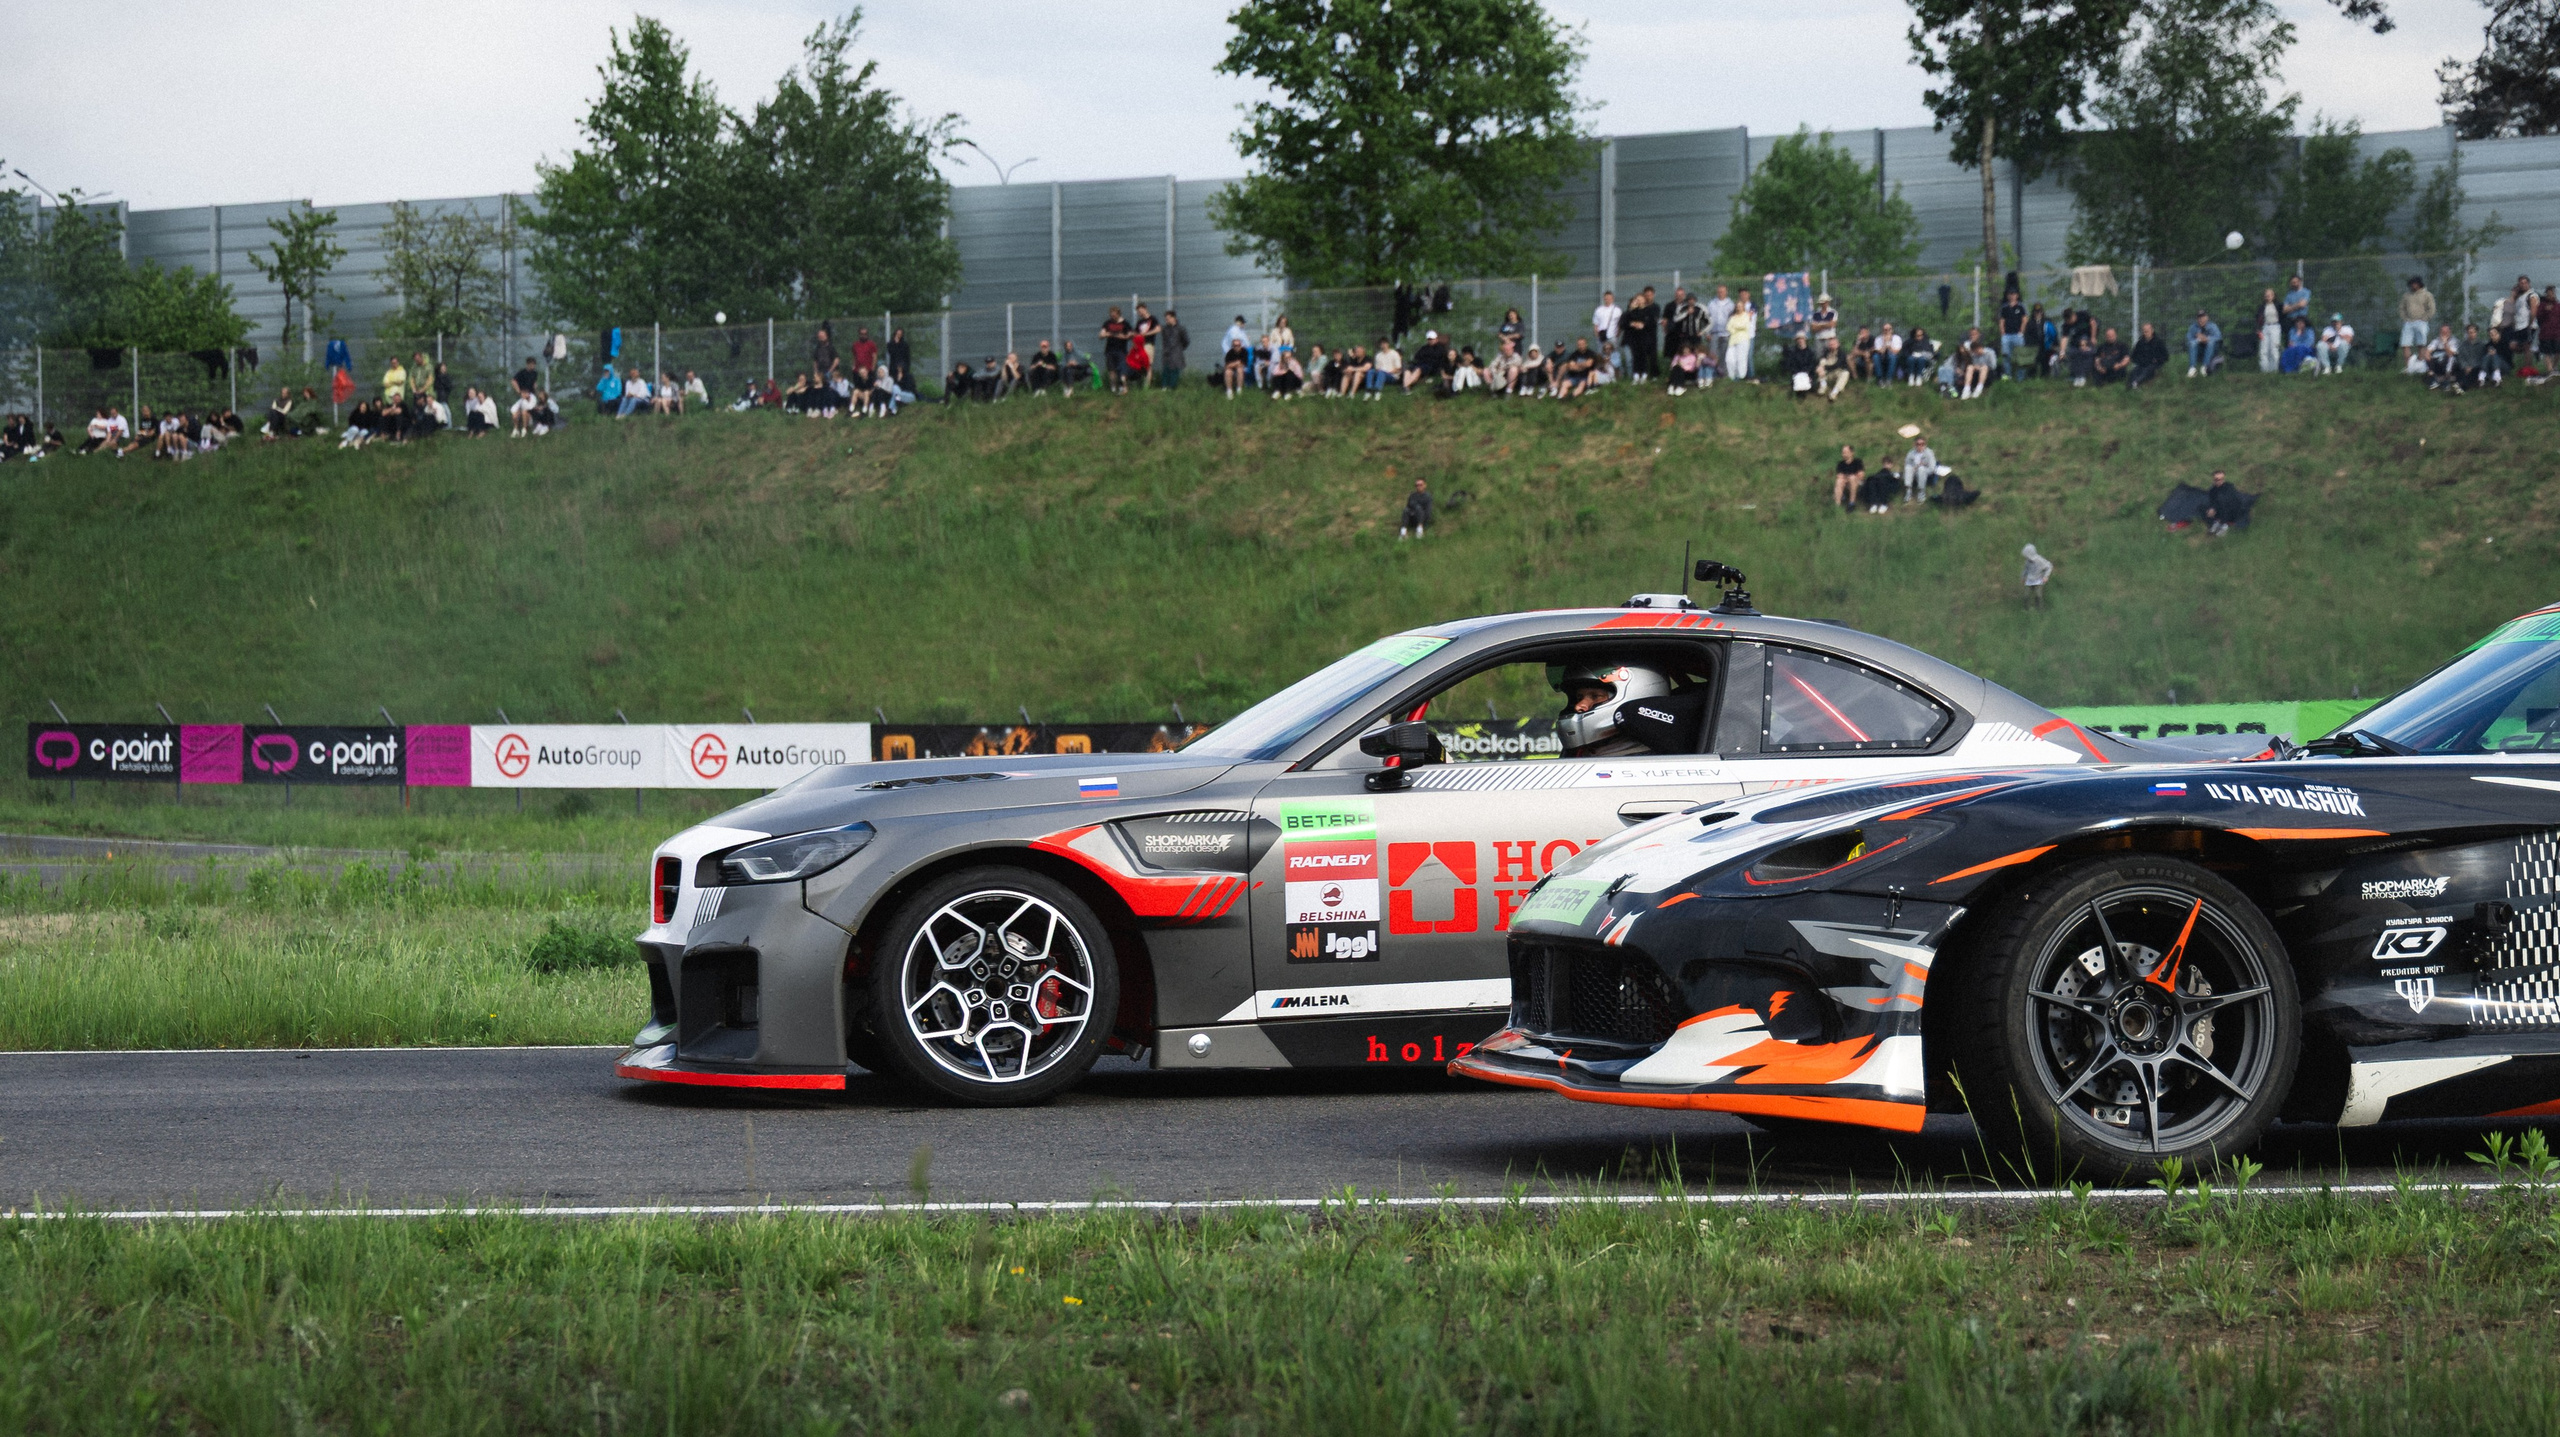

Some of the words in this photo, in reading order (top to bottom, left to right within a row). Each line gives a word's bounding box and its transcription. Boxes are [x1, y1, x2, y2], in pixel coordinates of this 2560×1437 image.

[538, 745, 642, 770] AutoGroup
[119, 762, 150, 774] detailing
[151, 763, 174, 773] studio
[340, 765, 374, 777] detailing
[375, 765, 398, 775] studio
[2204, 783, 2260, 804] ILYA
[2257, 786, 2367, 818] POLISHUK
[1145, 834, 1219, 846] SHOPMARKA
[1145, 844, 1194, 854] motorsport
[1195, 844, 1225, 854] design
[2361, 878, 2436, 893] SHOPMARKA
[2361, 888, 2411, 900] motorsport
[2411, 888, 2441, 898] design
[1299, 910, 1367, 922] BELSHINA
[2425, 915, 2454, 924] ЗАНОСА
[2381, 967, 2421, 977] PREDATOR
[1282, 994, 1350, 1009] MALENA
